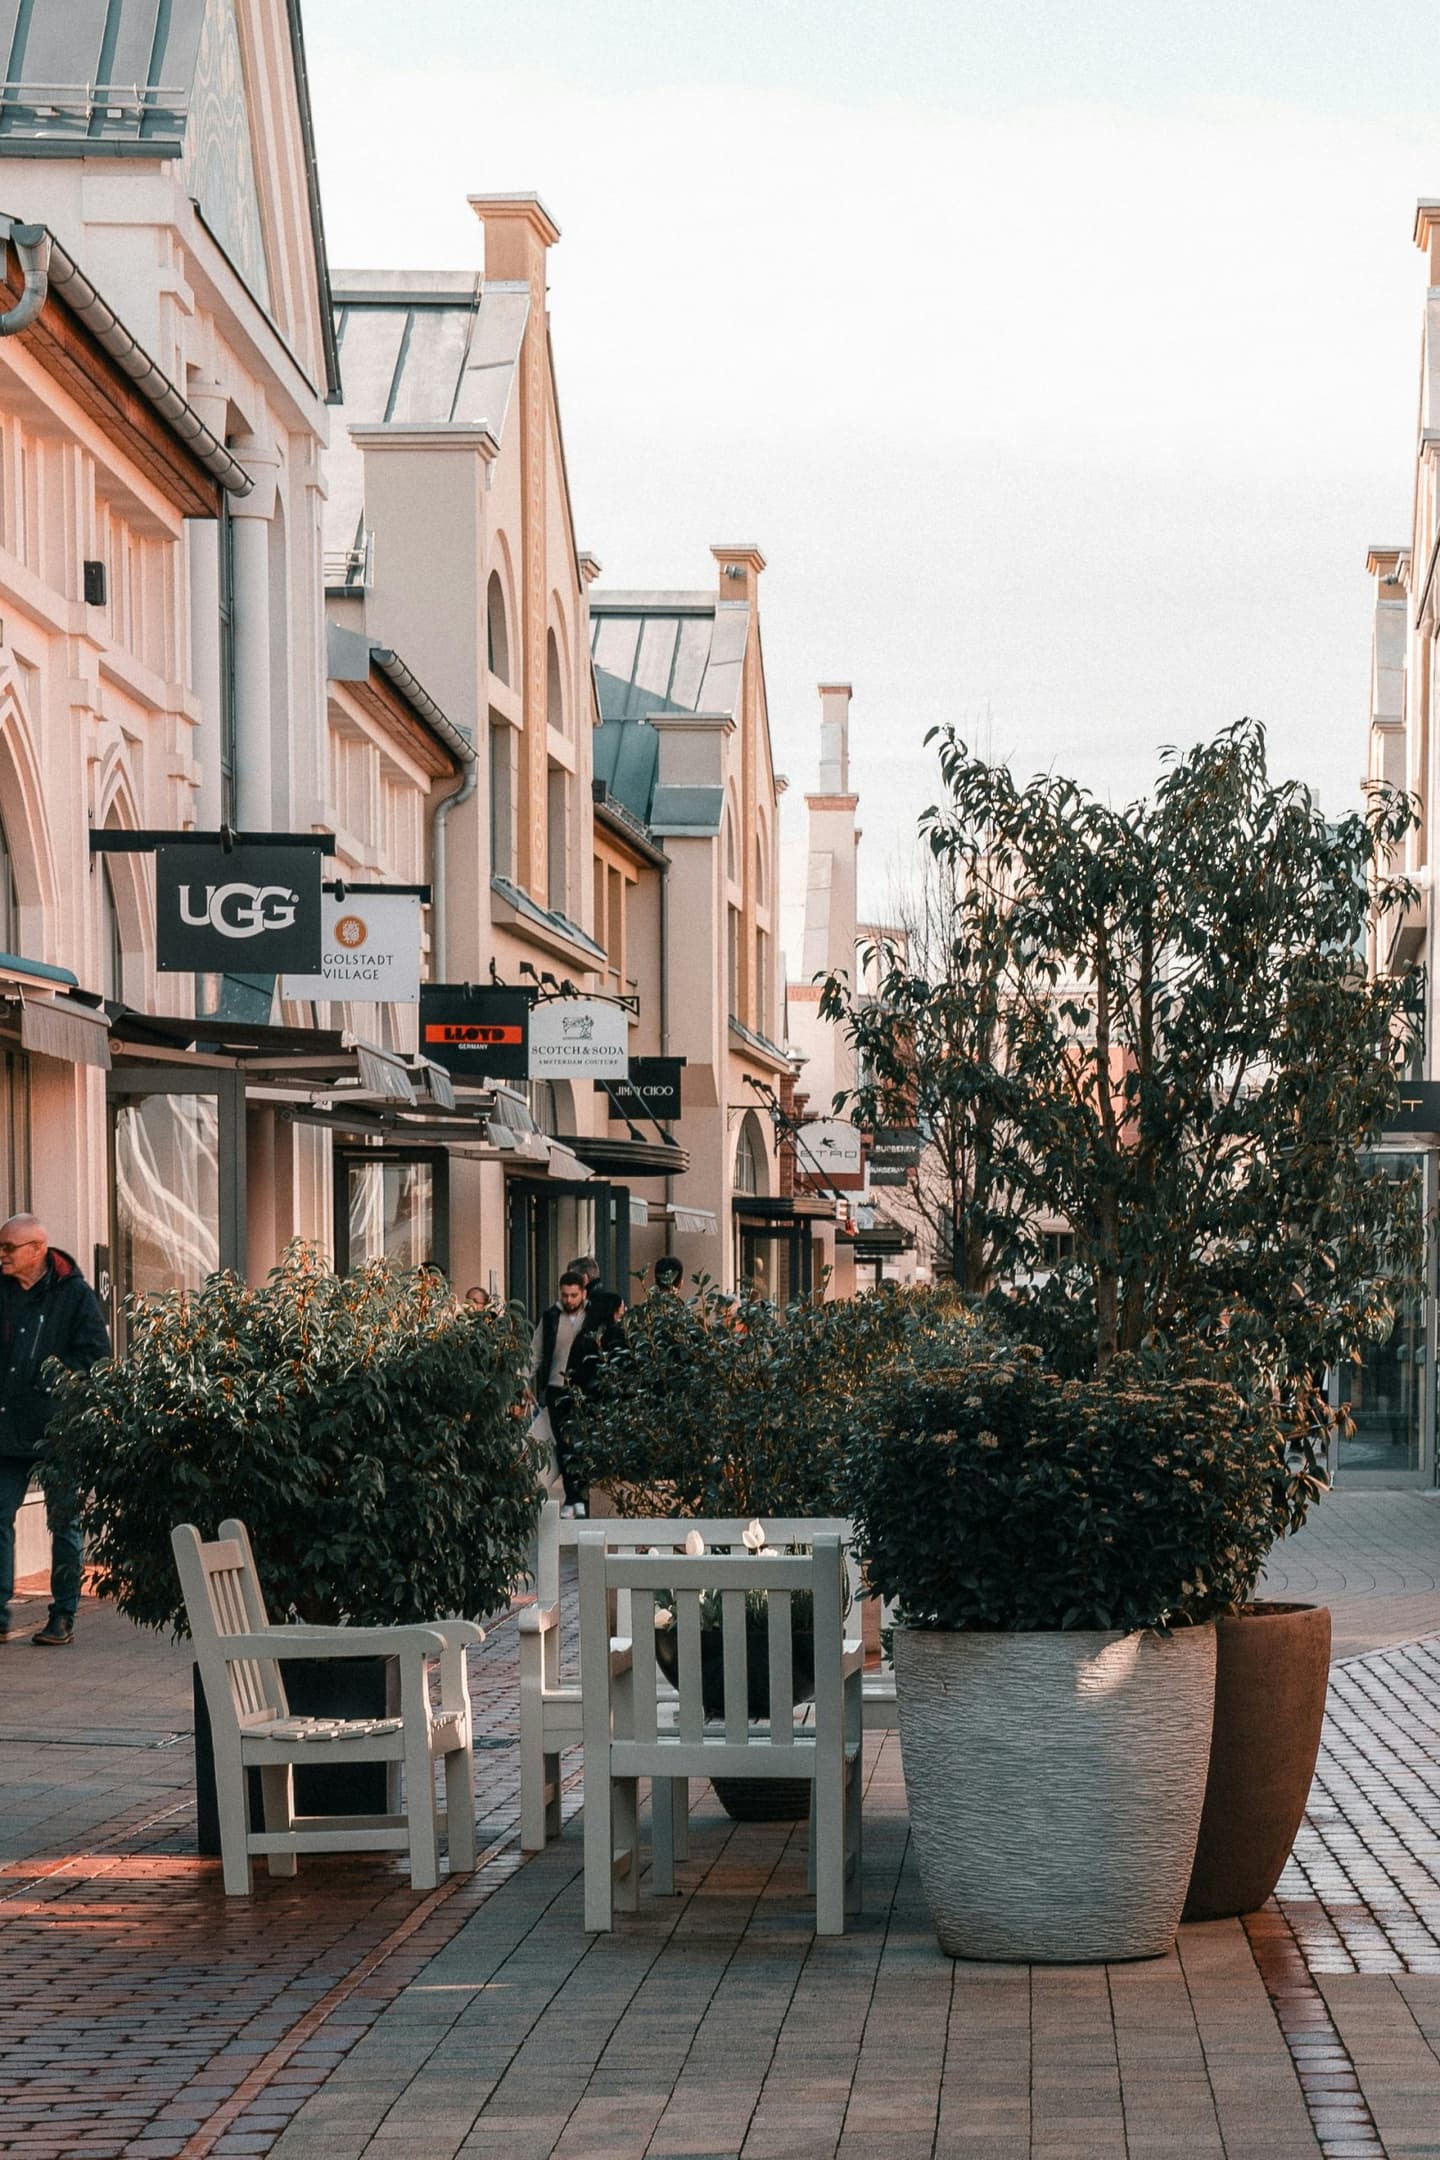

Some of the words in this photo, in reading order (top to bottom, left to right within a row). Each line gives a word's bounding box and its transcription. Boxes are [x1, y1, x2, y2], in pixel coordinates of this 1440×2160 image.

[178, 882, 298, 939] UGG
[322, 968, 380, 980] VILLAGE
[444, 1027, 505, 1041] LLOYD
[642, 1086, 674, 1097] CHOO
[869, 1166, 906, 1174] URBERRY
